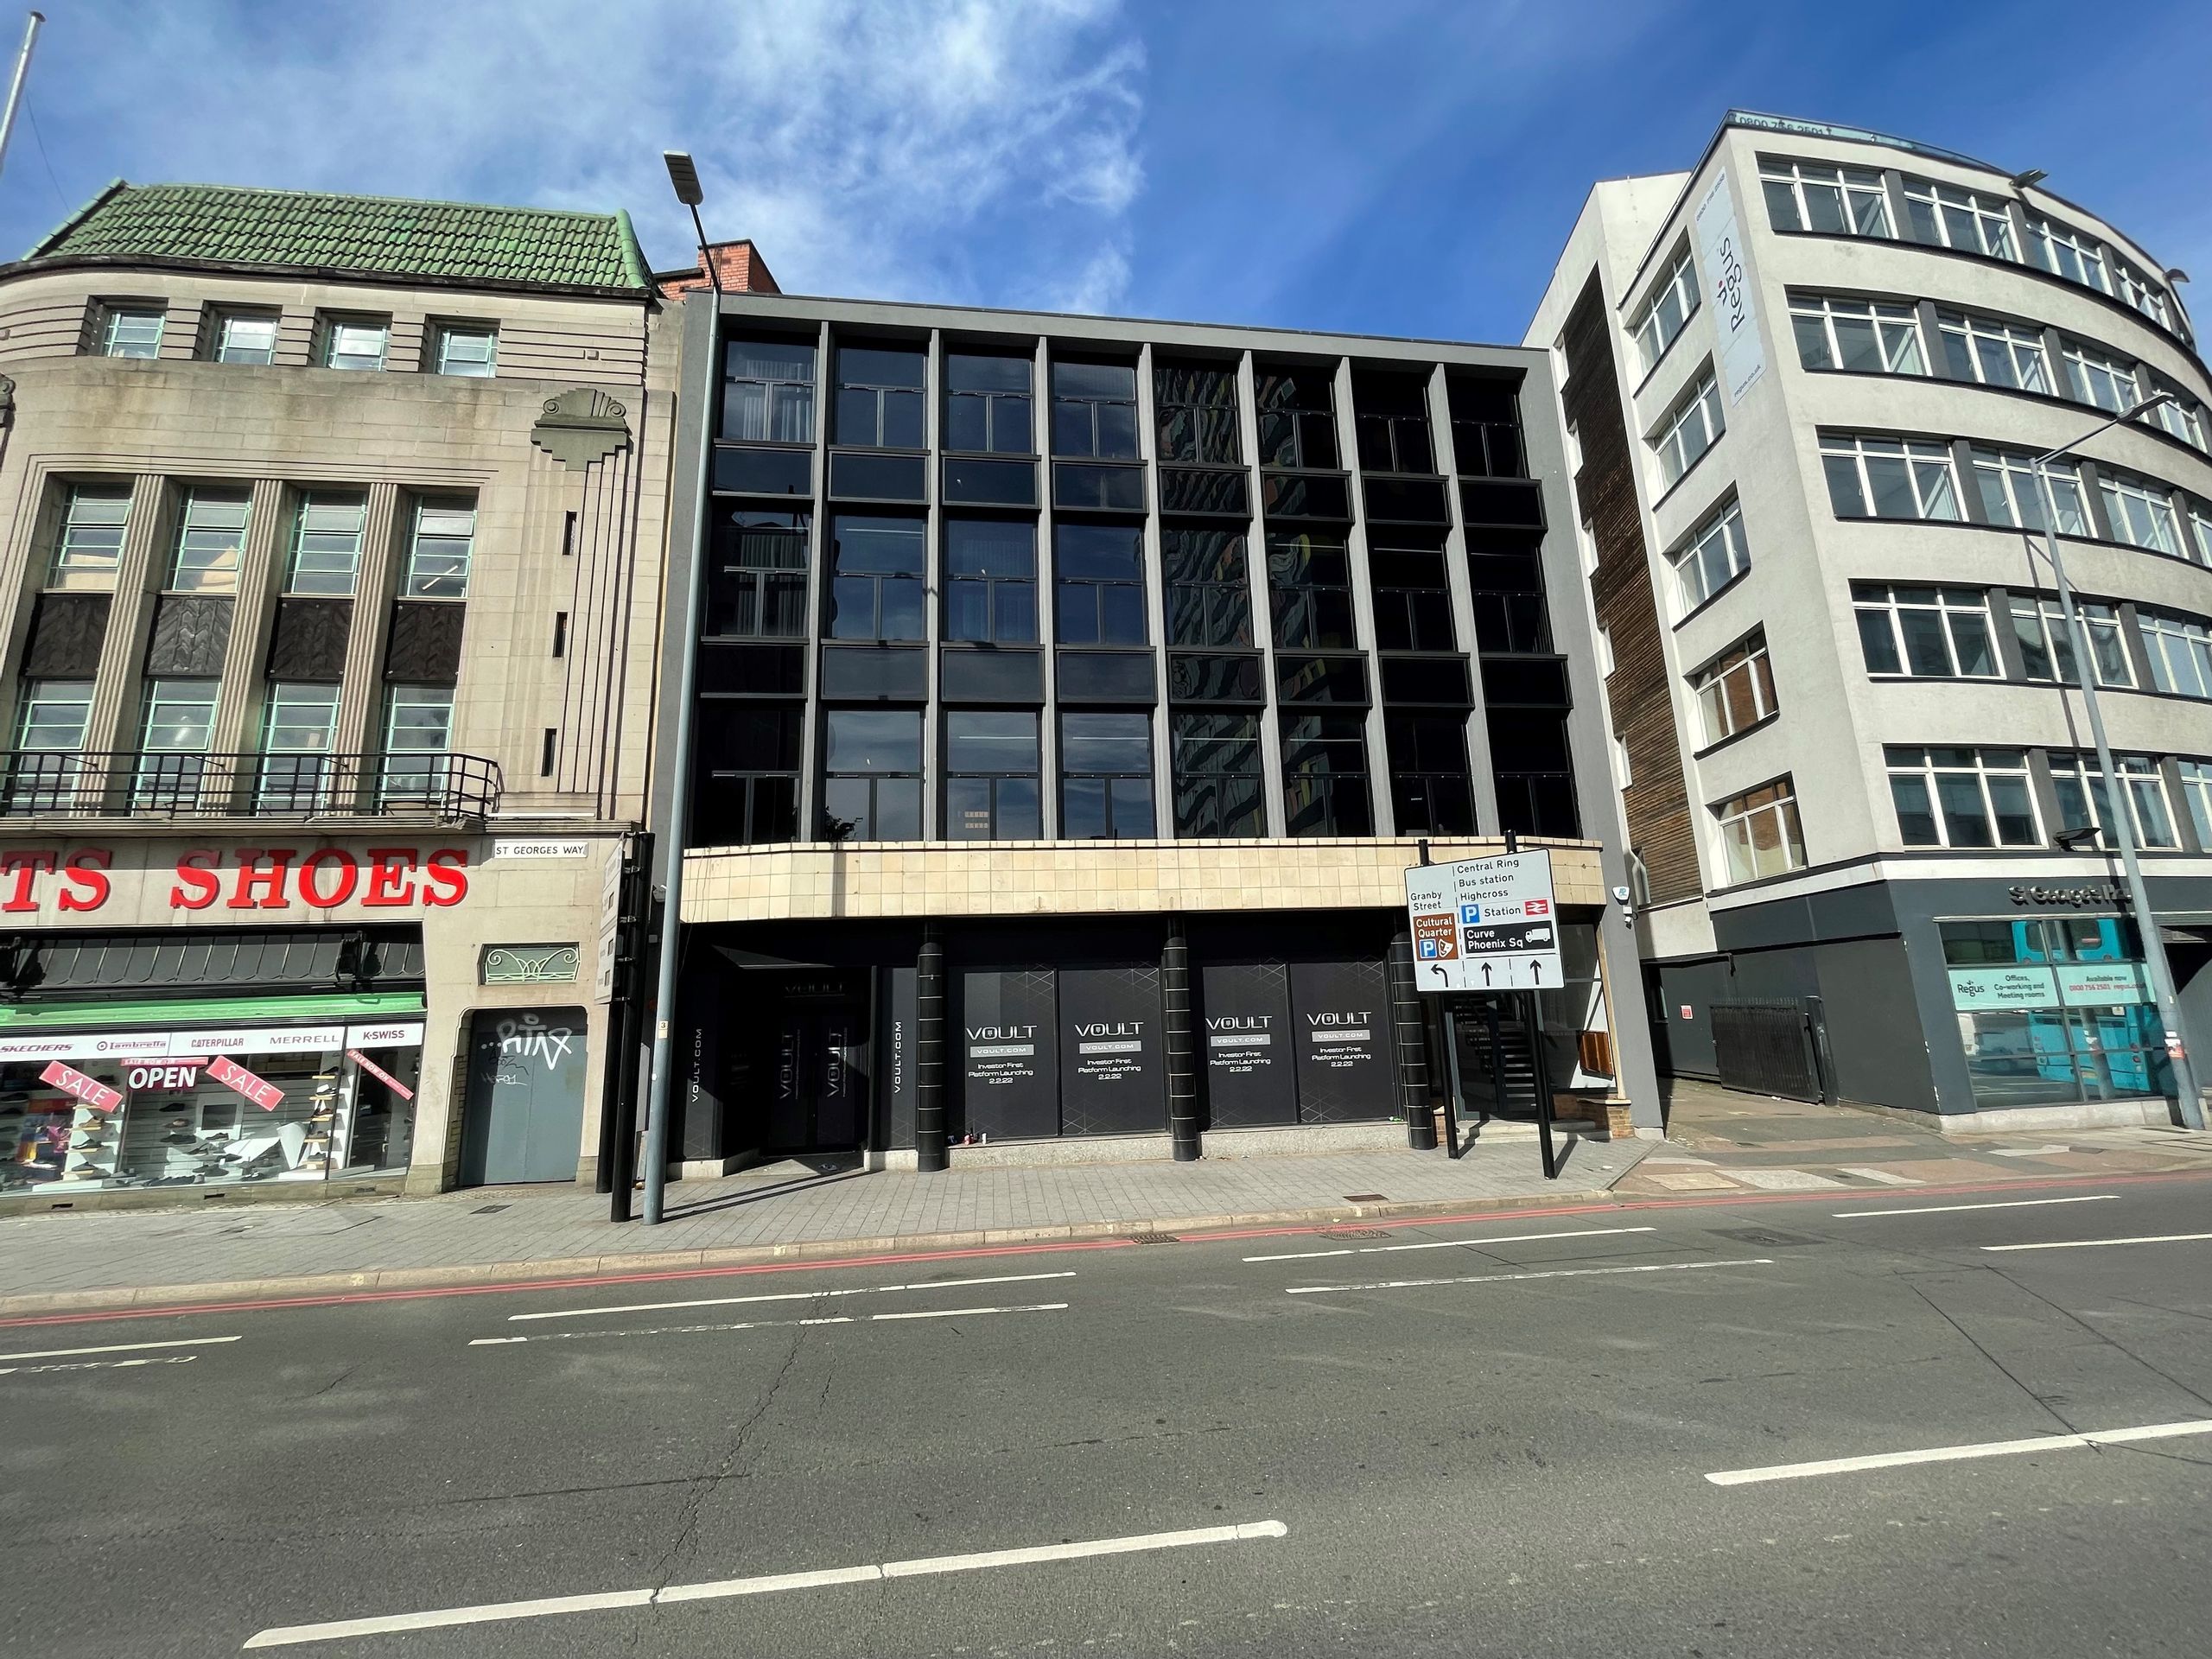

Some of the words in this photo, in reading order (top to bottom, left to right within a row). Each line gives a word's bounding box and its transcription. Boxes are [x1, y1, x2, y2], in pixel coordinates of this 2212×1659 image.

[1719, 237, 1745, 334] Regus
[513, 846, 558, 855] GEORGES
[563, 846, 584, 855] WAY
[1457, 861, 1493, 874] Central
[1497, 858, 1520, 868] Ring
[170, 849, 469, 911] SHOES
[1459, 879, 1477, 887] Bus
[1479, 874, 1514, 885] station
[1410, 892, 1442, 901] Granby
[1460, 888, 1509, 901] Highcross
[1414, 900, 1441, 911] Street
[1484, 906, 1521, 918] Station
[1415, 917, 1452, 928] Cultural
[1417, 927, 1452, 938] Quarter
[1466, 929, 1495, 939] Curve
[1468, 938, 1506, 950] Phoenix
[1509, 938, 1523, 949] Sq
[1957, 983, 1985, 997] Regus
[2032, 982, 2045, 990] and
[1997, 992, 2024, 1001] Meeting
[1205, 1015, 1273, 1030] VOULT
[1306, 1011, 1372, 1026] VOULT
[966, 1025, 1037, 1040] VOULT
[1075, 1021, 1144, 1037] VOULT
[191, 1038, 245, 1048] CATERPILLAR
[270, 1035, 340, 1045] MERRELL
[0, 1044, 73, 1053] SKECHERS
[365, 1060, 380, 1074] NOW
[691, 1028, 702, 1103] VOULT.COM
[129, 1066, 197, 1090] OPEN
[220, 1065, 272, 1103] SALE
[55, 1070, 108, 1106] SALE
